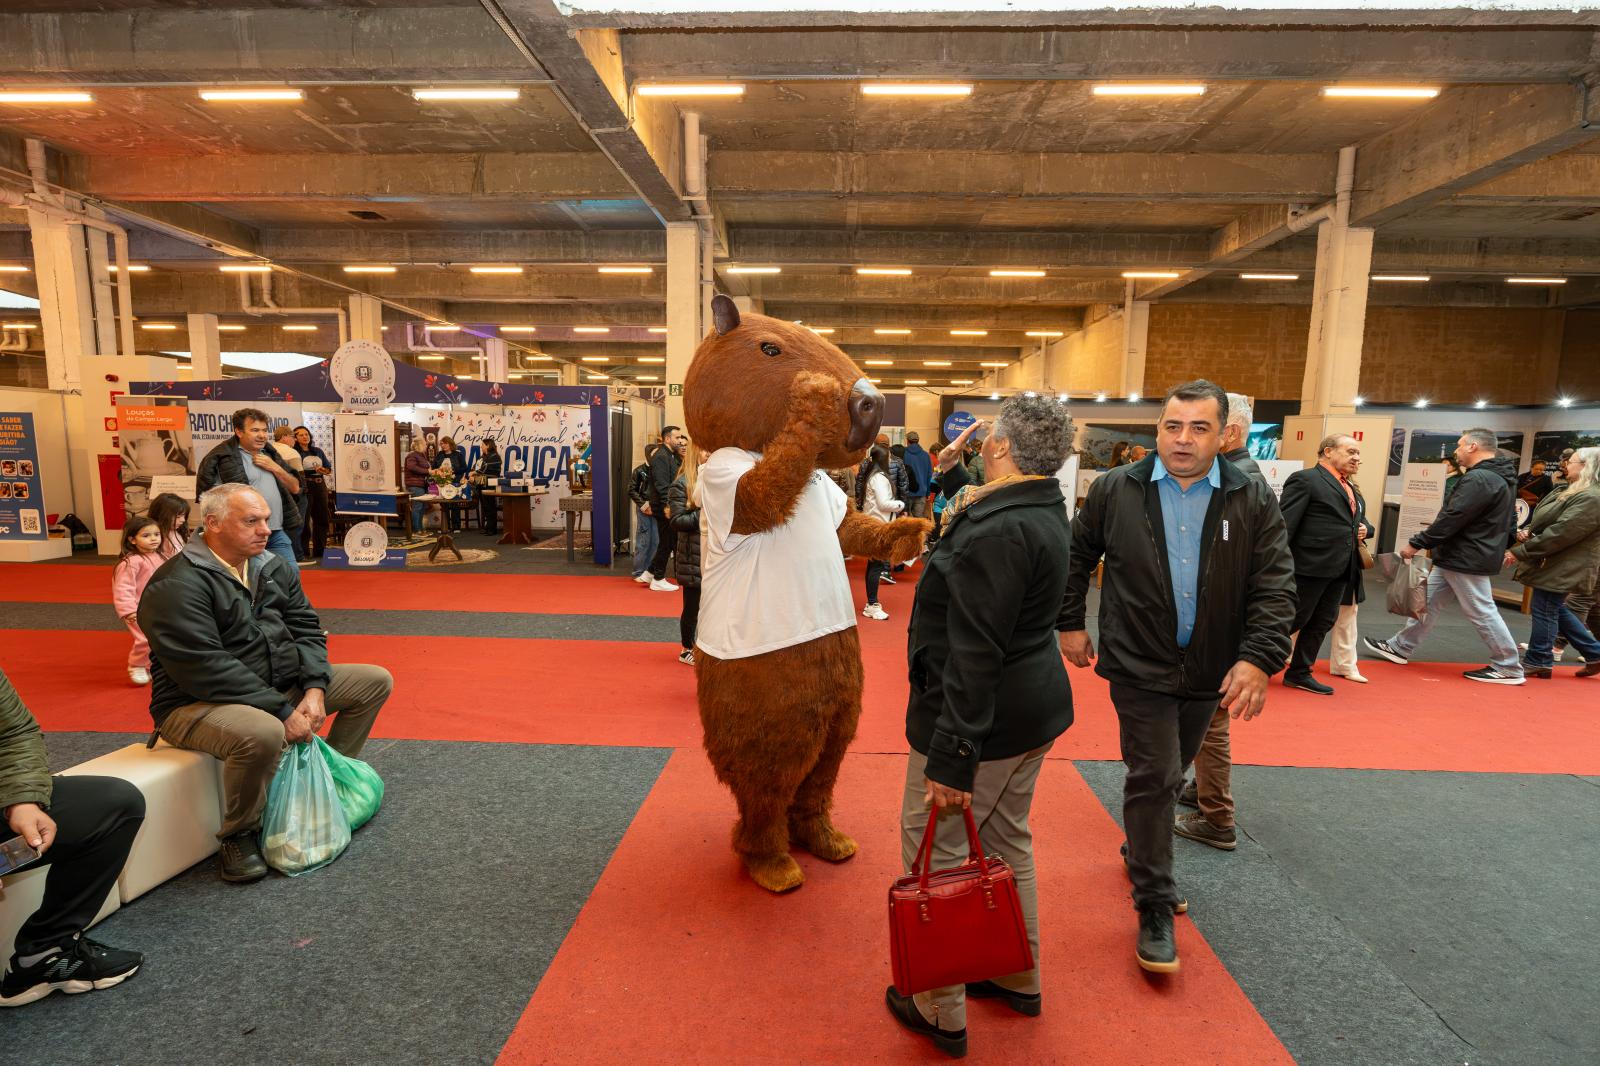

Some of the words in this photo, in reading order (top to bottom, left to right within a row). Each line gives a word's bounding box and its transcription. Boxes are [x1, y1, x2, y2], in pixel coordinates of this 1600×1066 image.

[359, 397, 379, 405] LOUÇA
[126, 409, 155, 417] Louças
[189, 413, 217, 432] RATO
[343, 433, 356, 443] DA
[357, 433, 387, 447] LOUÇA
[452, 425, 505, 447] Capital
[506, 424, 568, 446] Nacional
[503, 445, 571, 488] OUÇA
